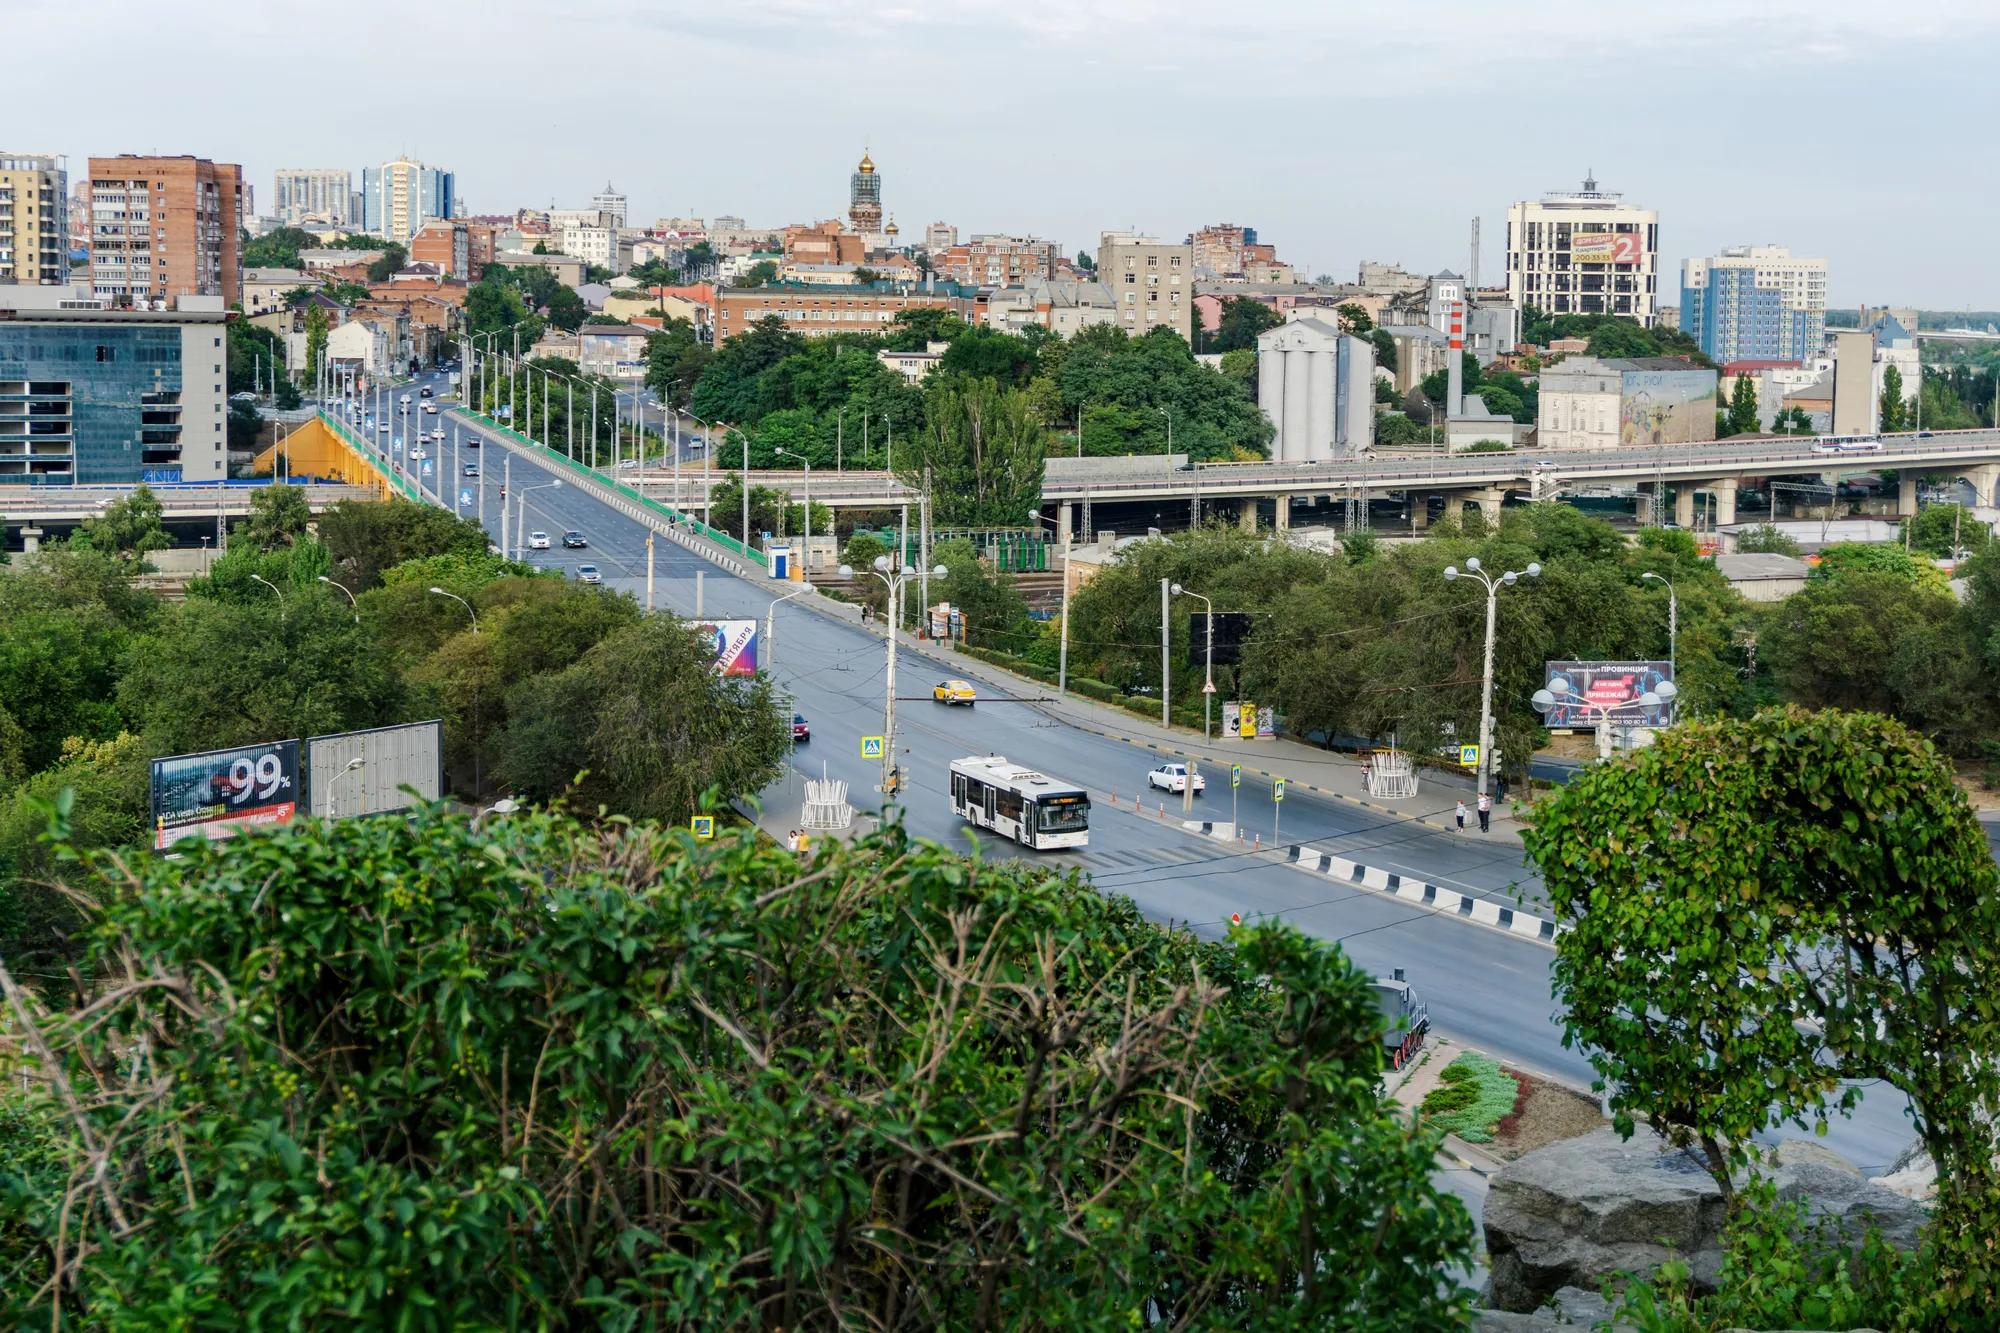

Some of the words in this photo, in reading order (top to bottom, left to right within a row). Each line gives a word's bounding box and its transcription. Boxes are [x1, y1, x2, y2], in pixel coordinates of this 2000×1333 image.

[1616, 237, 1633, 262] 2
[716, 626, 753, 670] ЕНТЯБРЯ
[1601, 665, 1649, 673] ПРОВИНЦИЯ
[157, 811, 176, 821] ADA
